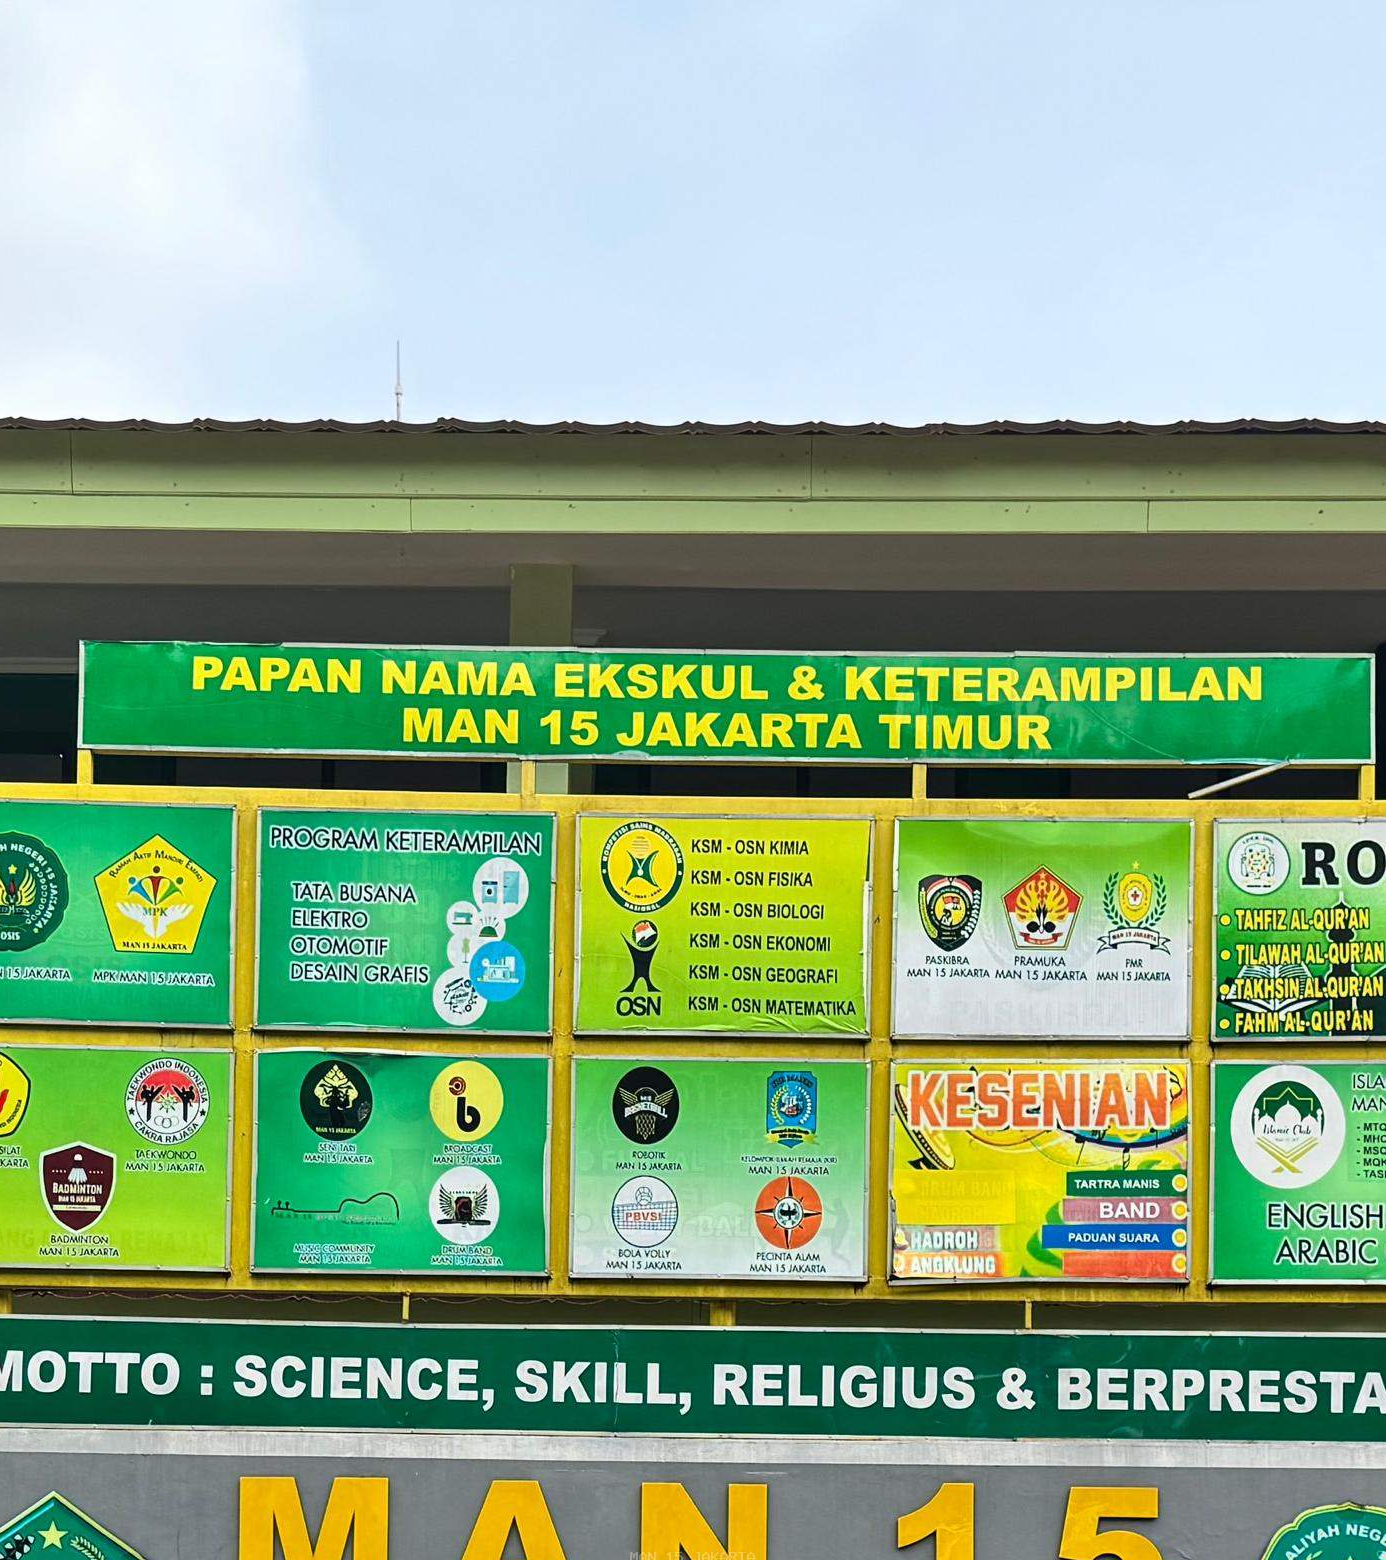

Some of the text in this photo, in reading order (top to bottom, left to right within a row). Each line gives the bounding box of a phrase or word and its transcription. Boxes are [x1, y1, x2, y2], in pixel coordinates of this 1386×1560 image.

[192, 656, 1262, 702] PAPAN NAMA EKSKUL & KETERAMPILAN
[402, 707, 1051, 751] MAN 15 JAKARTA TIMUR
[271, 828, 541, 853] PROGRAM KETERAMPILAN
[692, 840, 809, 855] KSM OSN KIMIA
[11, 844, 47, 866] NEGERI
[691, 871, 813, 887] KSM OSN FISIKA
[293, 883, 416, 903] TATA BUSANA
[143, 907, 167, 916] MPK
[691, 902, 825, 920] KSM OSN BIOLOGI
[293, 910, 368, 929] ELEKTRO
[1235, 909, 1369, 930] TAHFIZ AL-QUR'AN
[1, 932, 20, 940] OSIS
[690, 934, 831, 951] KSM OSN EKONOMI
[291, 937, 387, 955] OTOMOTIF
[1236, 943, 1384, 965] TILAWAH AL-QUR'AN
[925, 956, 969, 965] PASKIBRA
[1014, 957, 1065, 966] PRAMUKA
[1126, 959, 1143, 968] PMR
[7, 968, 19, 981] 15
[22, 968, 71, 981] JAKARTA
[94, 972, 214, 986] MPK MAN 15 JAKARTA
[291, 964, 428, 984] DESAIN GRAFIS
[689, 965, 838, 984] KSM OSN GEOGRAFI
[907, 969, 990, 978] MAN 15 JAKARTA
[995, 970, 1087, 981] MAN 15 JAKARTA
[1097, 972, 1170, 981] MAN 15 JAKARTA
[1235, 976, 1383, 999] TAKHSIN AL-QUR'AN
[617, 996, 661, 1016] OSN
[688, 996, 856, 1016] KSM OSN MATEMATIKA
[1235, 1010, 1374, 1033] FAHM AL-QUR'AN
[128, 1061, 208, 1103] TAEKWONDO INDONESIA
[912, 1073, 1167, 1127] KESENIAN
[1364, 1123, 1386, 1132] MTQ
[0, 1146, 20, 1155] SILAT
[136, 1150, 196, 1159] TAEKWONDO
[444, 1145, 491, 1153] BROADCAST
[777, 1166, 786, 1174] 15
[790, 1167, 829, 1175] JAKARTA
[53, 1183, 102, 1194] BADMINTON
[1075, 1180, 1159, 1189] TARTRA MANIS
[625, 1212, 661, 1222] PBVSI
[1099, 1203, 1159, 1218] BAND
[1267, 1204, 1383, 1229] ENGLISH
[51, 1235, 108, 1244] BADMINTON
[912, 1231, 978, 1249] HADROH
[1069, 1233, 1159, 1242] PADUAN SUARA
[619, 1249, 670, 1258] BOLA VOLLY
[757, 1252, 820, 1262] PECINTA ALAM
[1275, 1240, 1377, 1265] ARABIC
[913, 1256, 995, 1274] ANGKLUNG
[233, 1353, 495, 1409] SCIENCE,
[515, 1358, 692, 1413] SKILL,
[712, 1364, 976, 1409] RELIGIUS
[996, 1367, 1035, 1410] &
